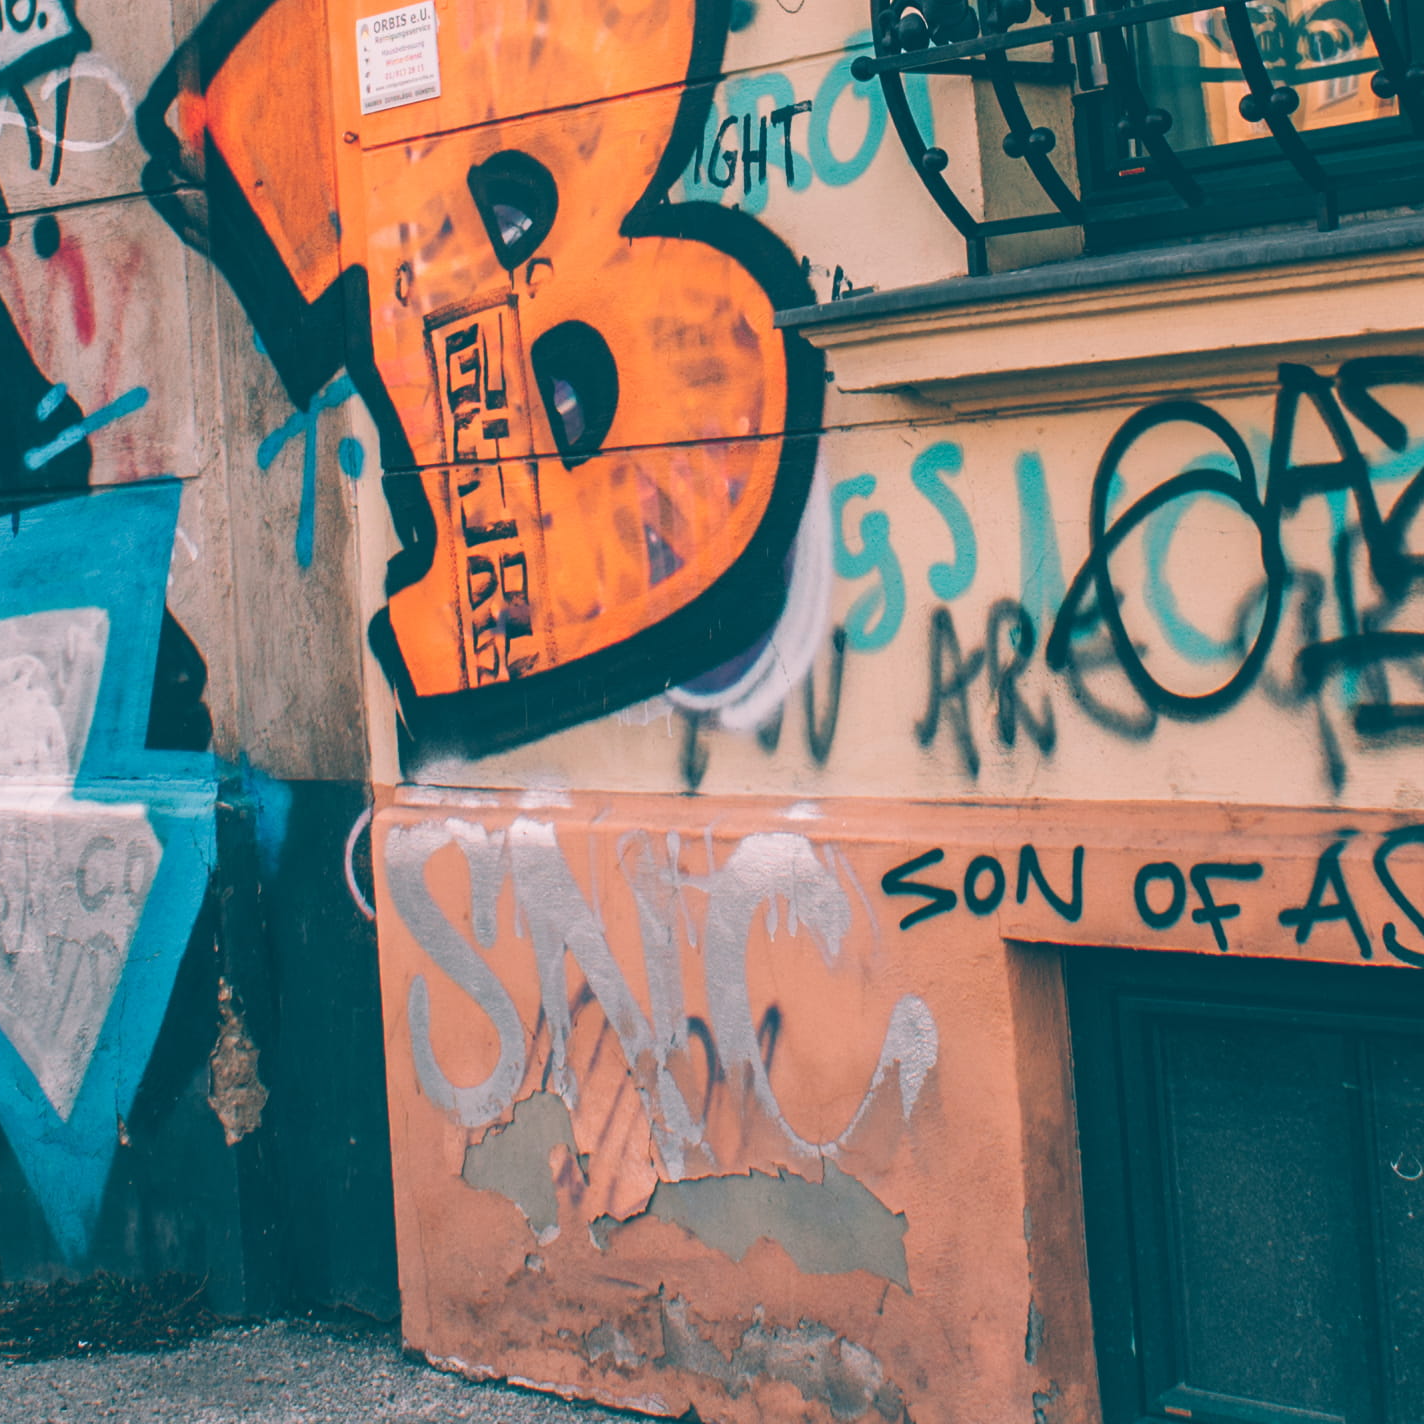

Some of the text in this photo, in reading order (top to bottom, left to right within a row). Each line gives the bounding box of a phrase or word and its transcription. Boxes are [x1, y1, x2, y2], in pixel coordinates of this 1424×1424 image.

[373, 7, 431, 34] ORBIS e.U.
[880, 844, 1085, 931] SON
[1134, 861, 1264, 952] OF
